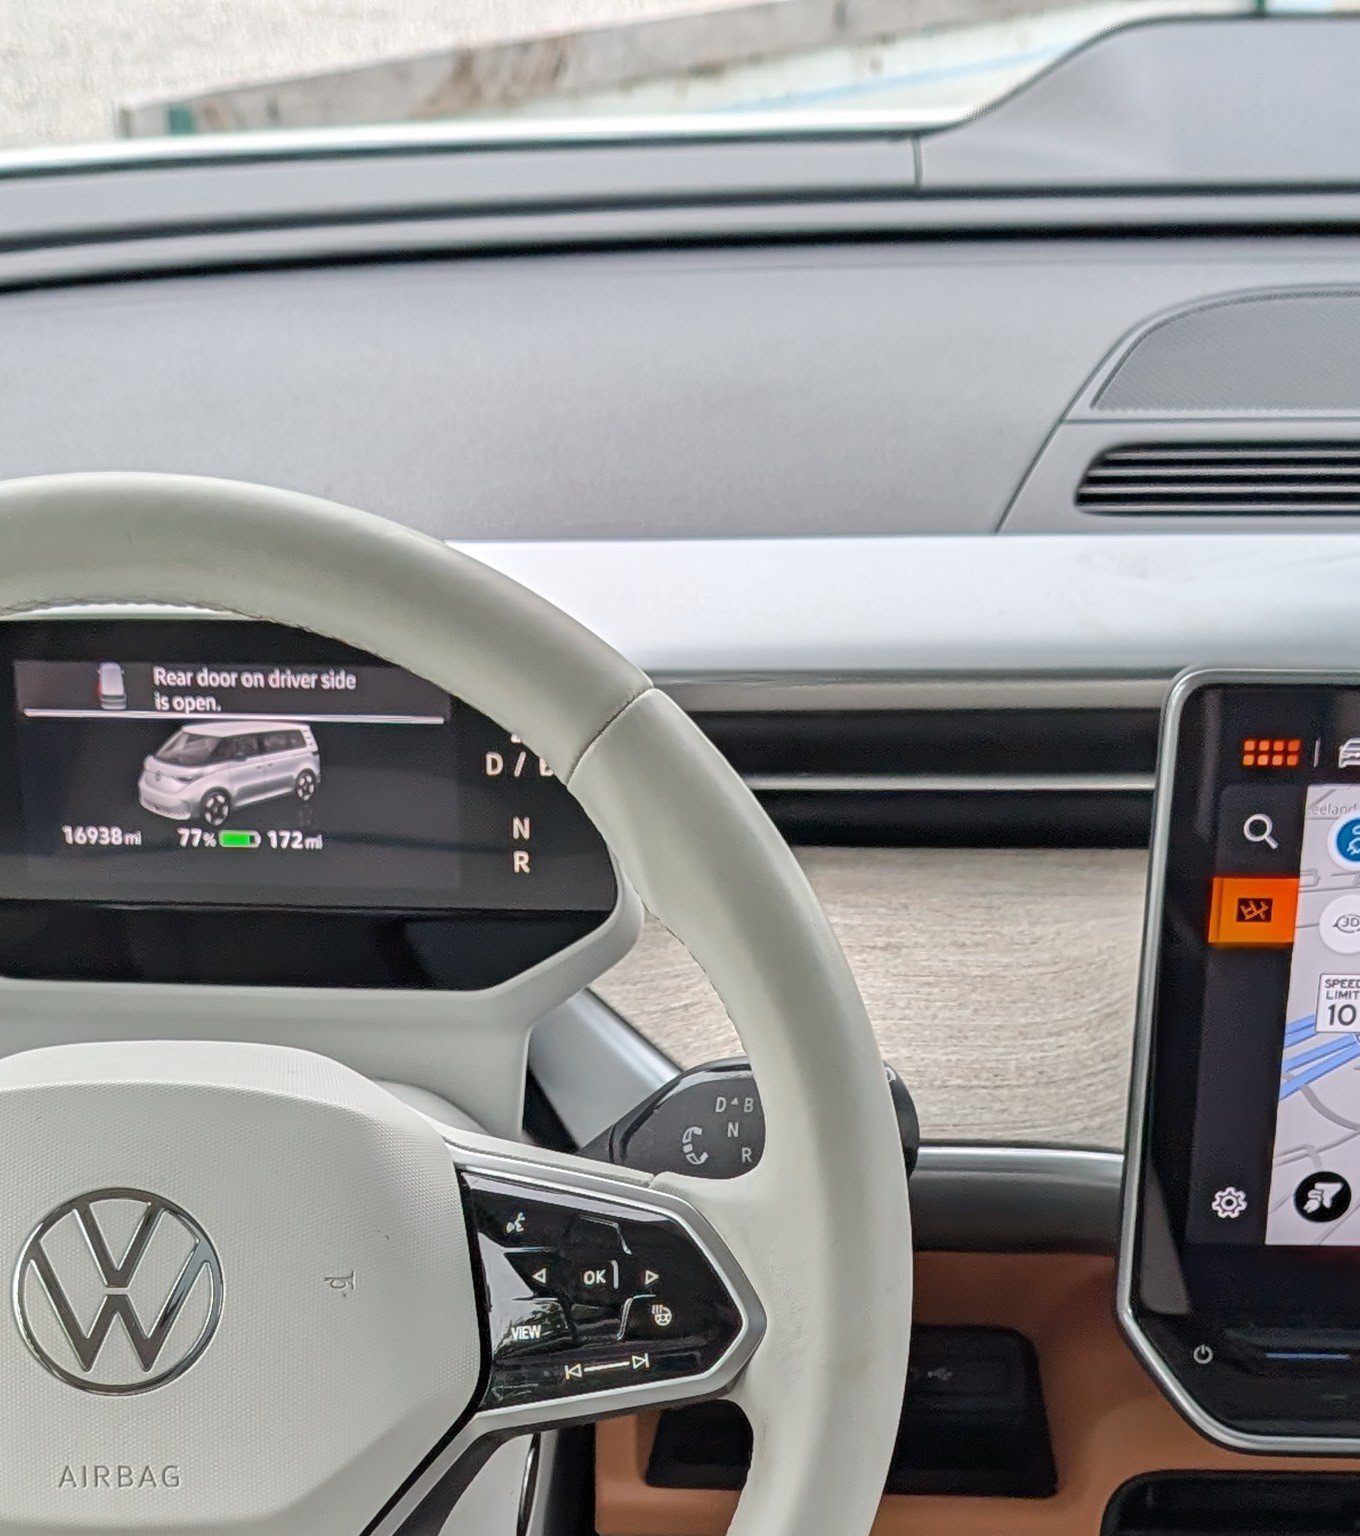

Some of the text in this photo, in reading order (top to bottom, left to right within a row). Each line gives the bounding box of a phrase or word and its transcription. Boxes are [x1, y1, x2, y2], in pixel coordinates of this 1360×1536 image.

[153, 667, 357, 690] Rear door on driver side
[154, 692, 222, 714] is open.
[485, 752, 504, 776] D
[512, 816, 531, 840] N
[512, 850, 531, 874] R
[1342, 916, 1360, 928] 3D
[1326, 989, 1360, 1000] LIMIT
[1327, 1003, 1357, 1026] 10
[715, 1096, 754, 1114] D B
[728, 1121, 739, 1138] N
[742, 1146, 753, 1163] R
[583, 1268, 607, 1285] OK
[510, 1324, 542, 1340] VIEW
[57, 1463, 181, 1490] AIRBAG
